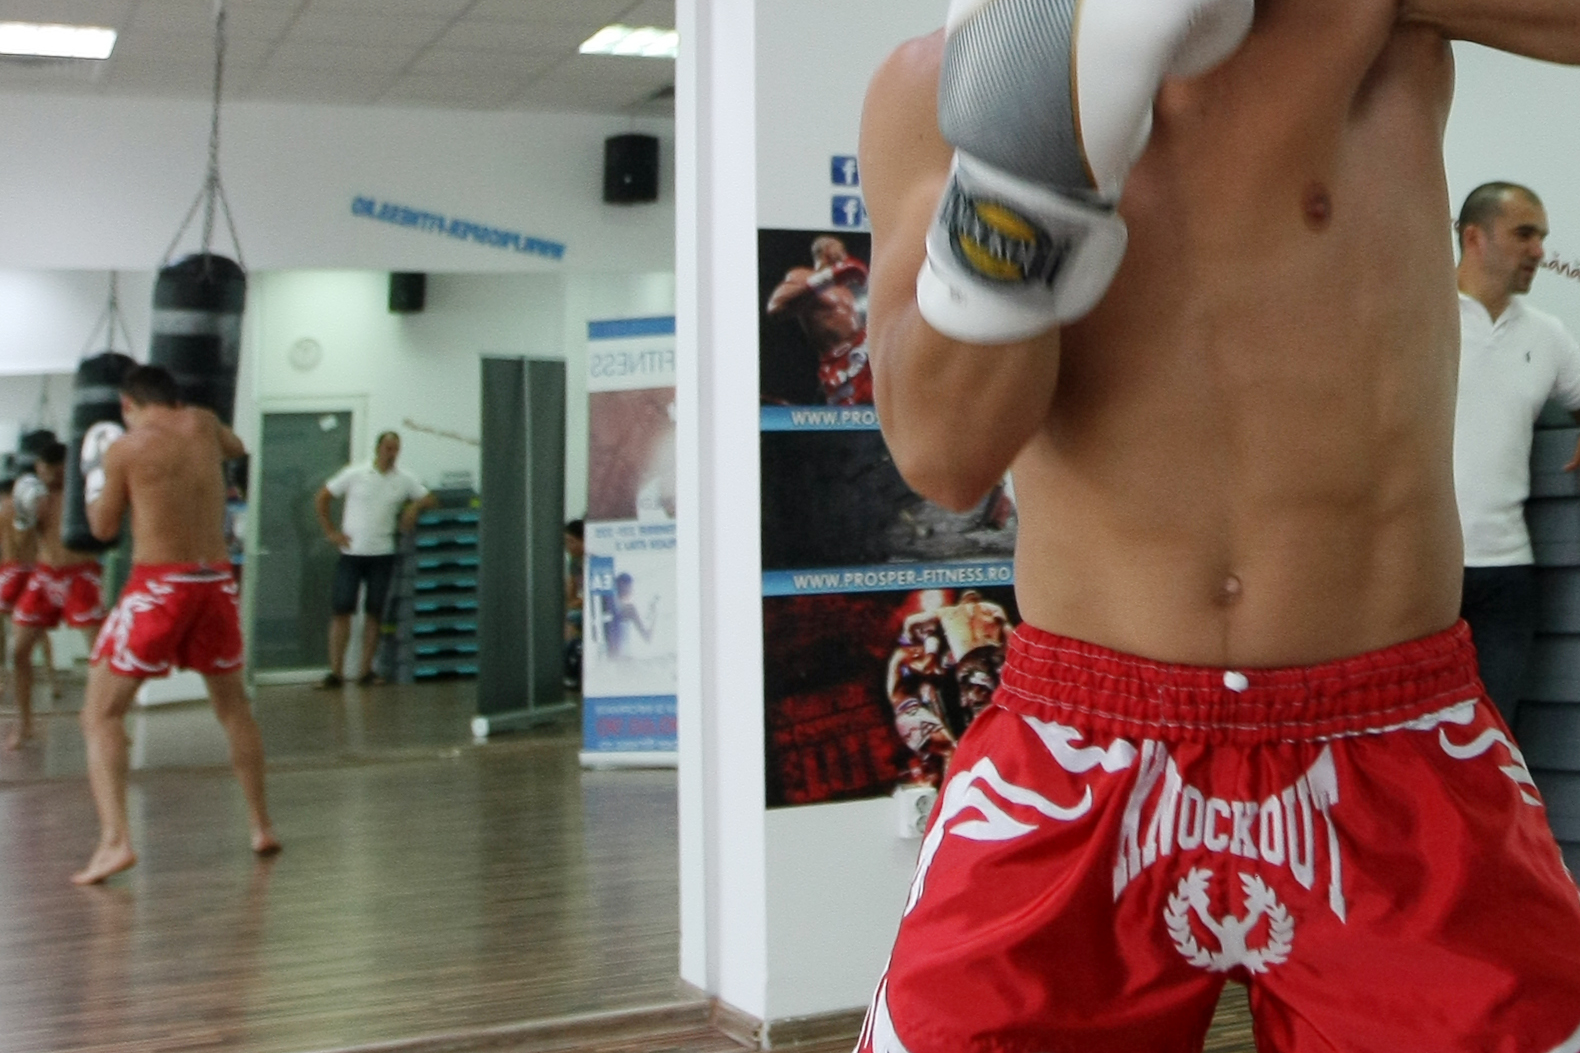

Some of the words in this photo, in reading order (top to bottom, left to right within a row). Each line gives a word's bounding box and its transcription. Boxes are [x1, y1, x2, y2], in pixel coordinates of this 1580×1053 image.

[791, 410, 880, 426] WWW.PRO
[793, 567, 1012, 589] WWW.PROSPER-FITNESS.RO
[1112, 738, 1346, 924] KNOCKOUT
